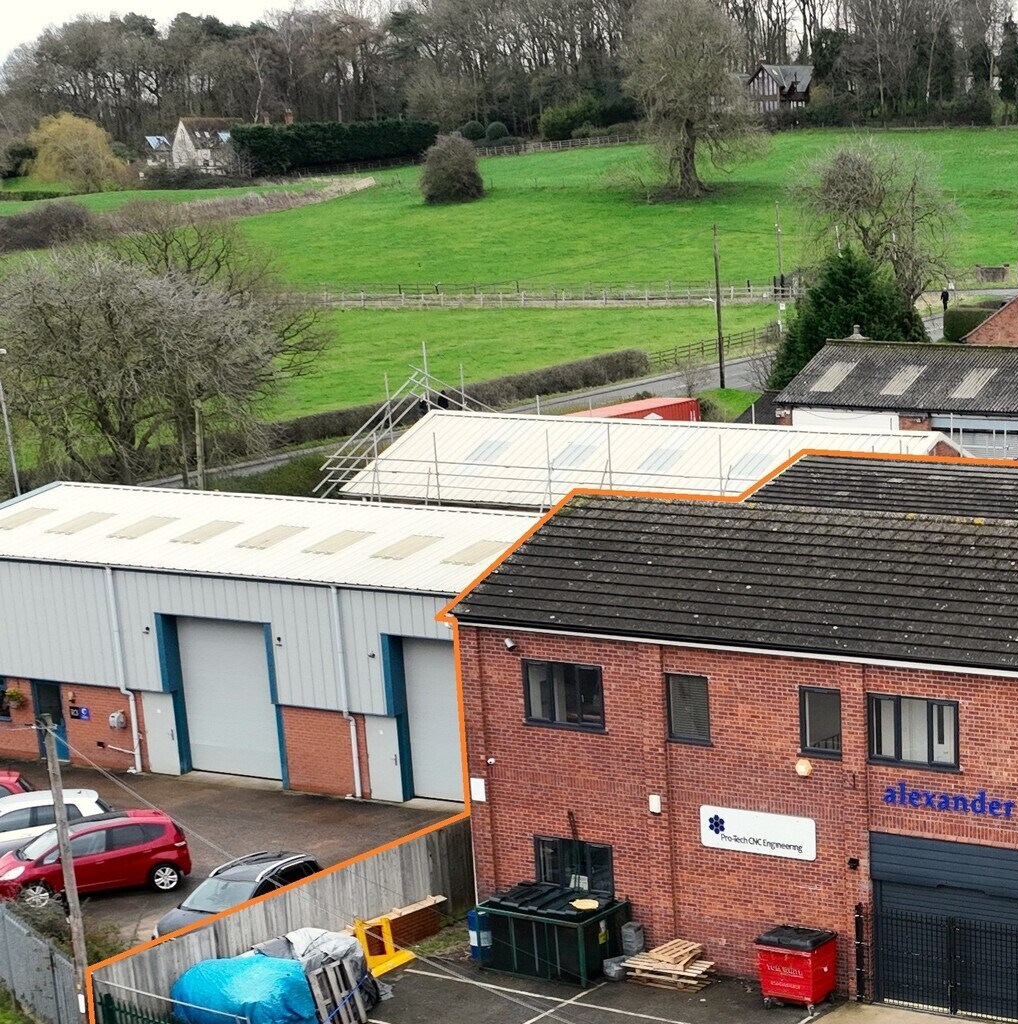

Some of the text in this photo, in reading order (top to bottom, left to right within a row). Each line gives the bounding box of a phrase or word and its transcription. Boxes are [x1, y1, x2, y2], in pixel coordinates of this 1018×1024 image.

[882, 780, 1016, 820] alexander
[720, 833, 803, 853] Pro-Tech CNC Engineering
